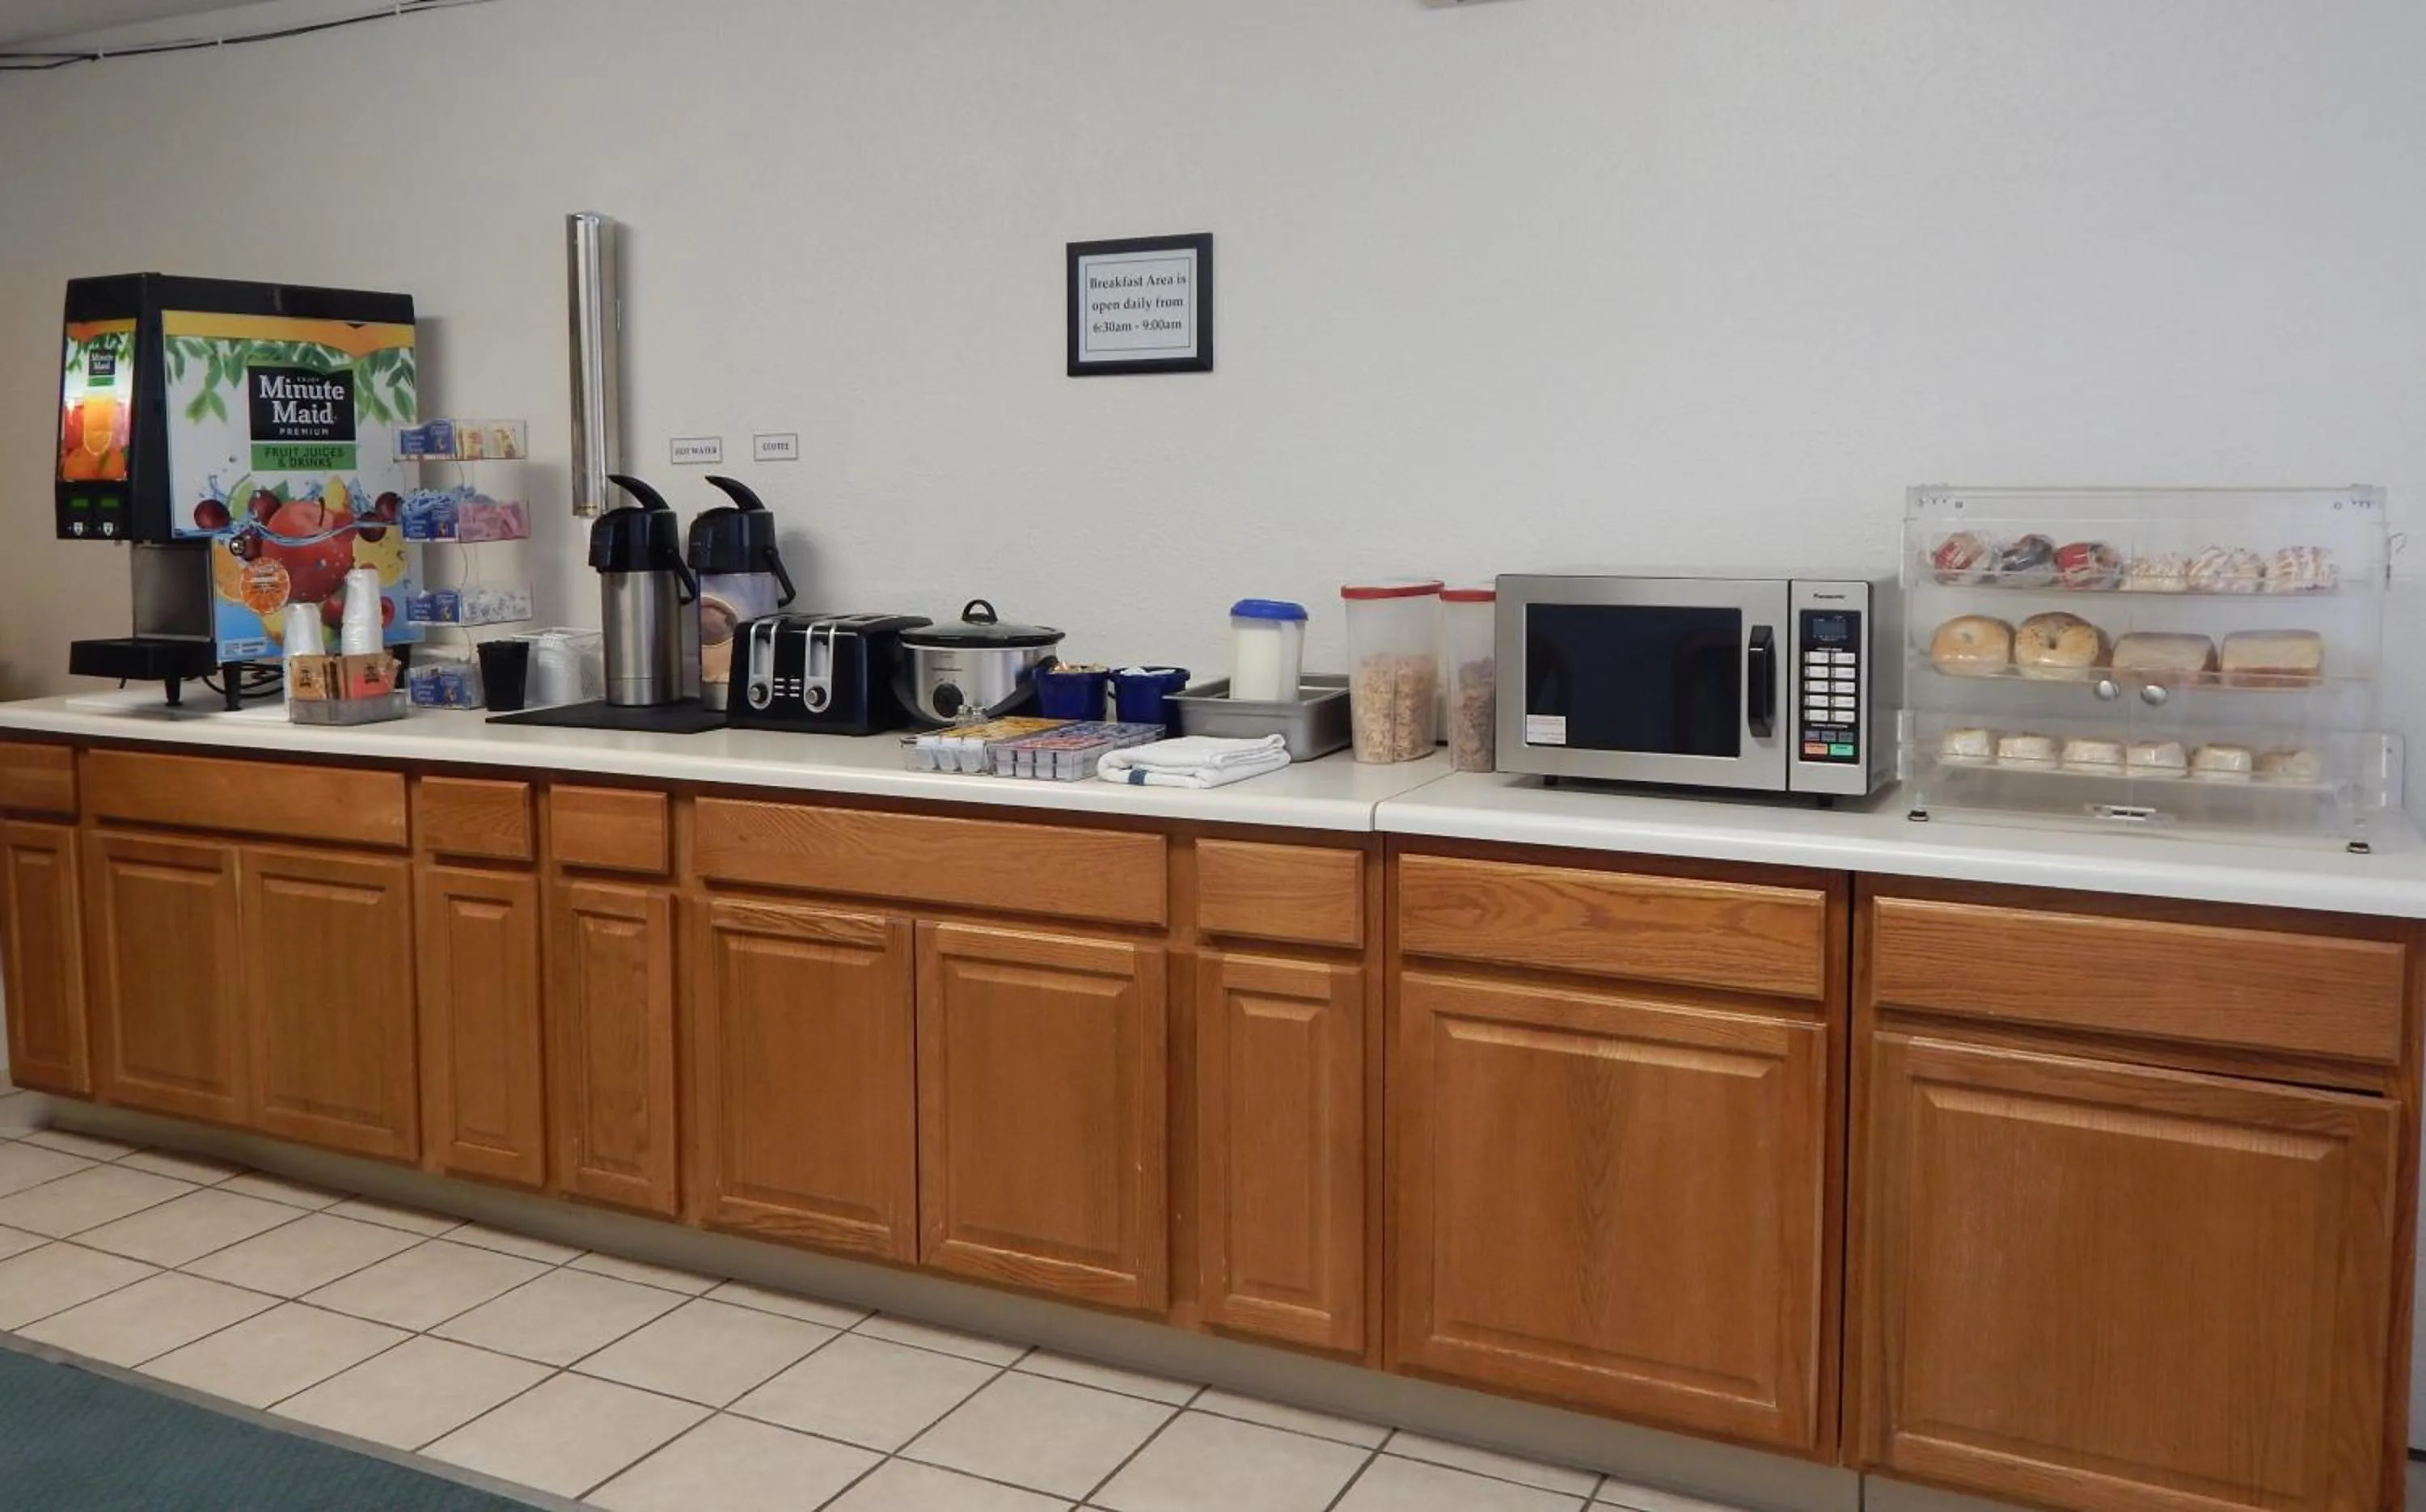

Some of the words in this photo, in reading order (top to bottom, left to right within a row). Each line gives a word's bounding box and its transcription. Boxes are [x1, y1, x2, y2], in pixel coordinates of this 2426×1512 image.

[1089, 276, 1143, 289] Breakfast
[1146, 274, 1174, 286] Area
[1177, 272, 1186, 285] is
[1092, 301, 1120, 314] open
[1123, 297, 1152, 312] daily
[1156, 297, 1183, 308] from
[1093, 320, 1131, 333] 6:30am
[1142, 319, 1181, 331] 9:00am
[259, 374, 345, 400] Minute
[272, 400, 335, 424] Maid
[279, 428, 329, 436] PREMIUM
[264, 446, 299, 458] FRUIT
[303, 446, 344, 458] JUICES
[290, 457, 332, 468] DRINKS
